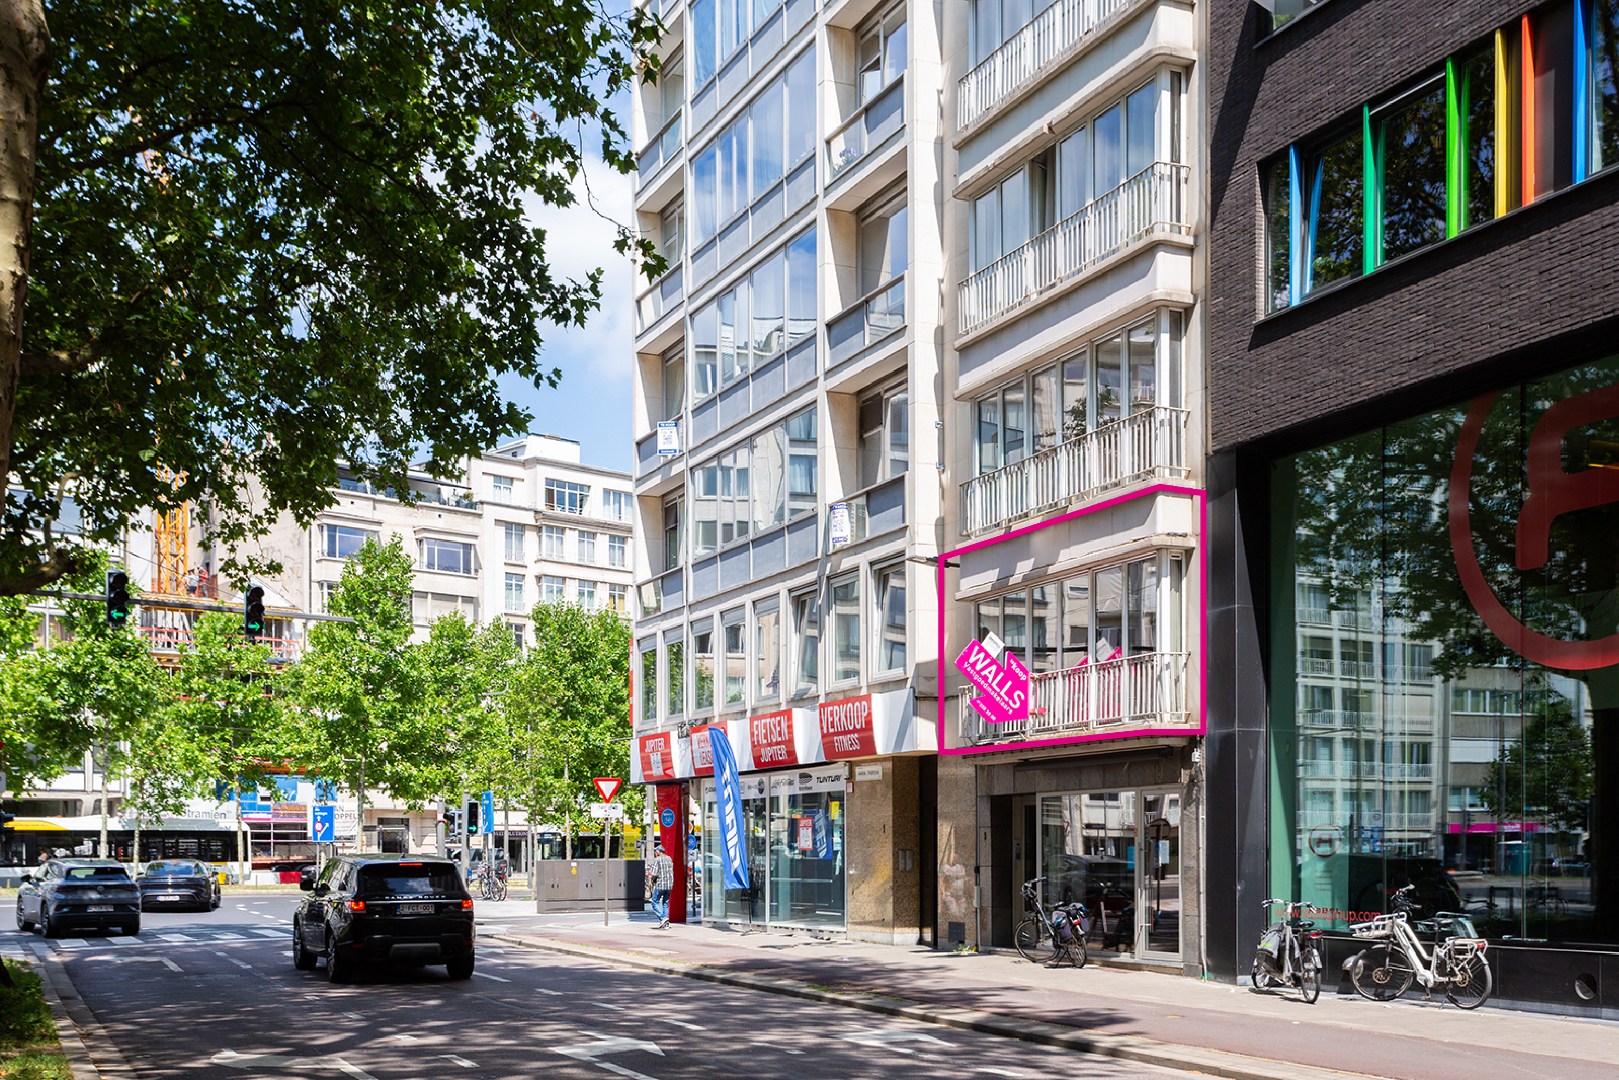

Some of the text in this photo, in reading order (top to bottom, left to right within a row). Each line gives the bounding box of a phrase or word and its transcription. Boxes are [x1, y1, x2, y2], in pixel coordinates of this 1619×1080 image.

[968, 645, 1025, 709] WALLS
[821, 700, 868, 734] VERKOOP
[753, 715, 789, 745] FIETSEN
[645, 737, 665, 753] JUPITER
[760, 744, 788, 763] JUPITER
[833, 733, 860, 752] FITNESS
